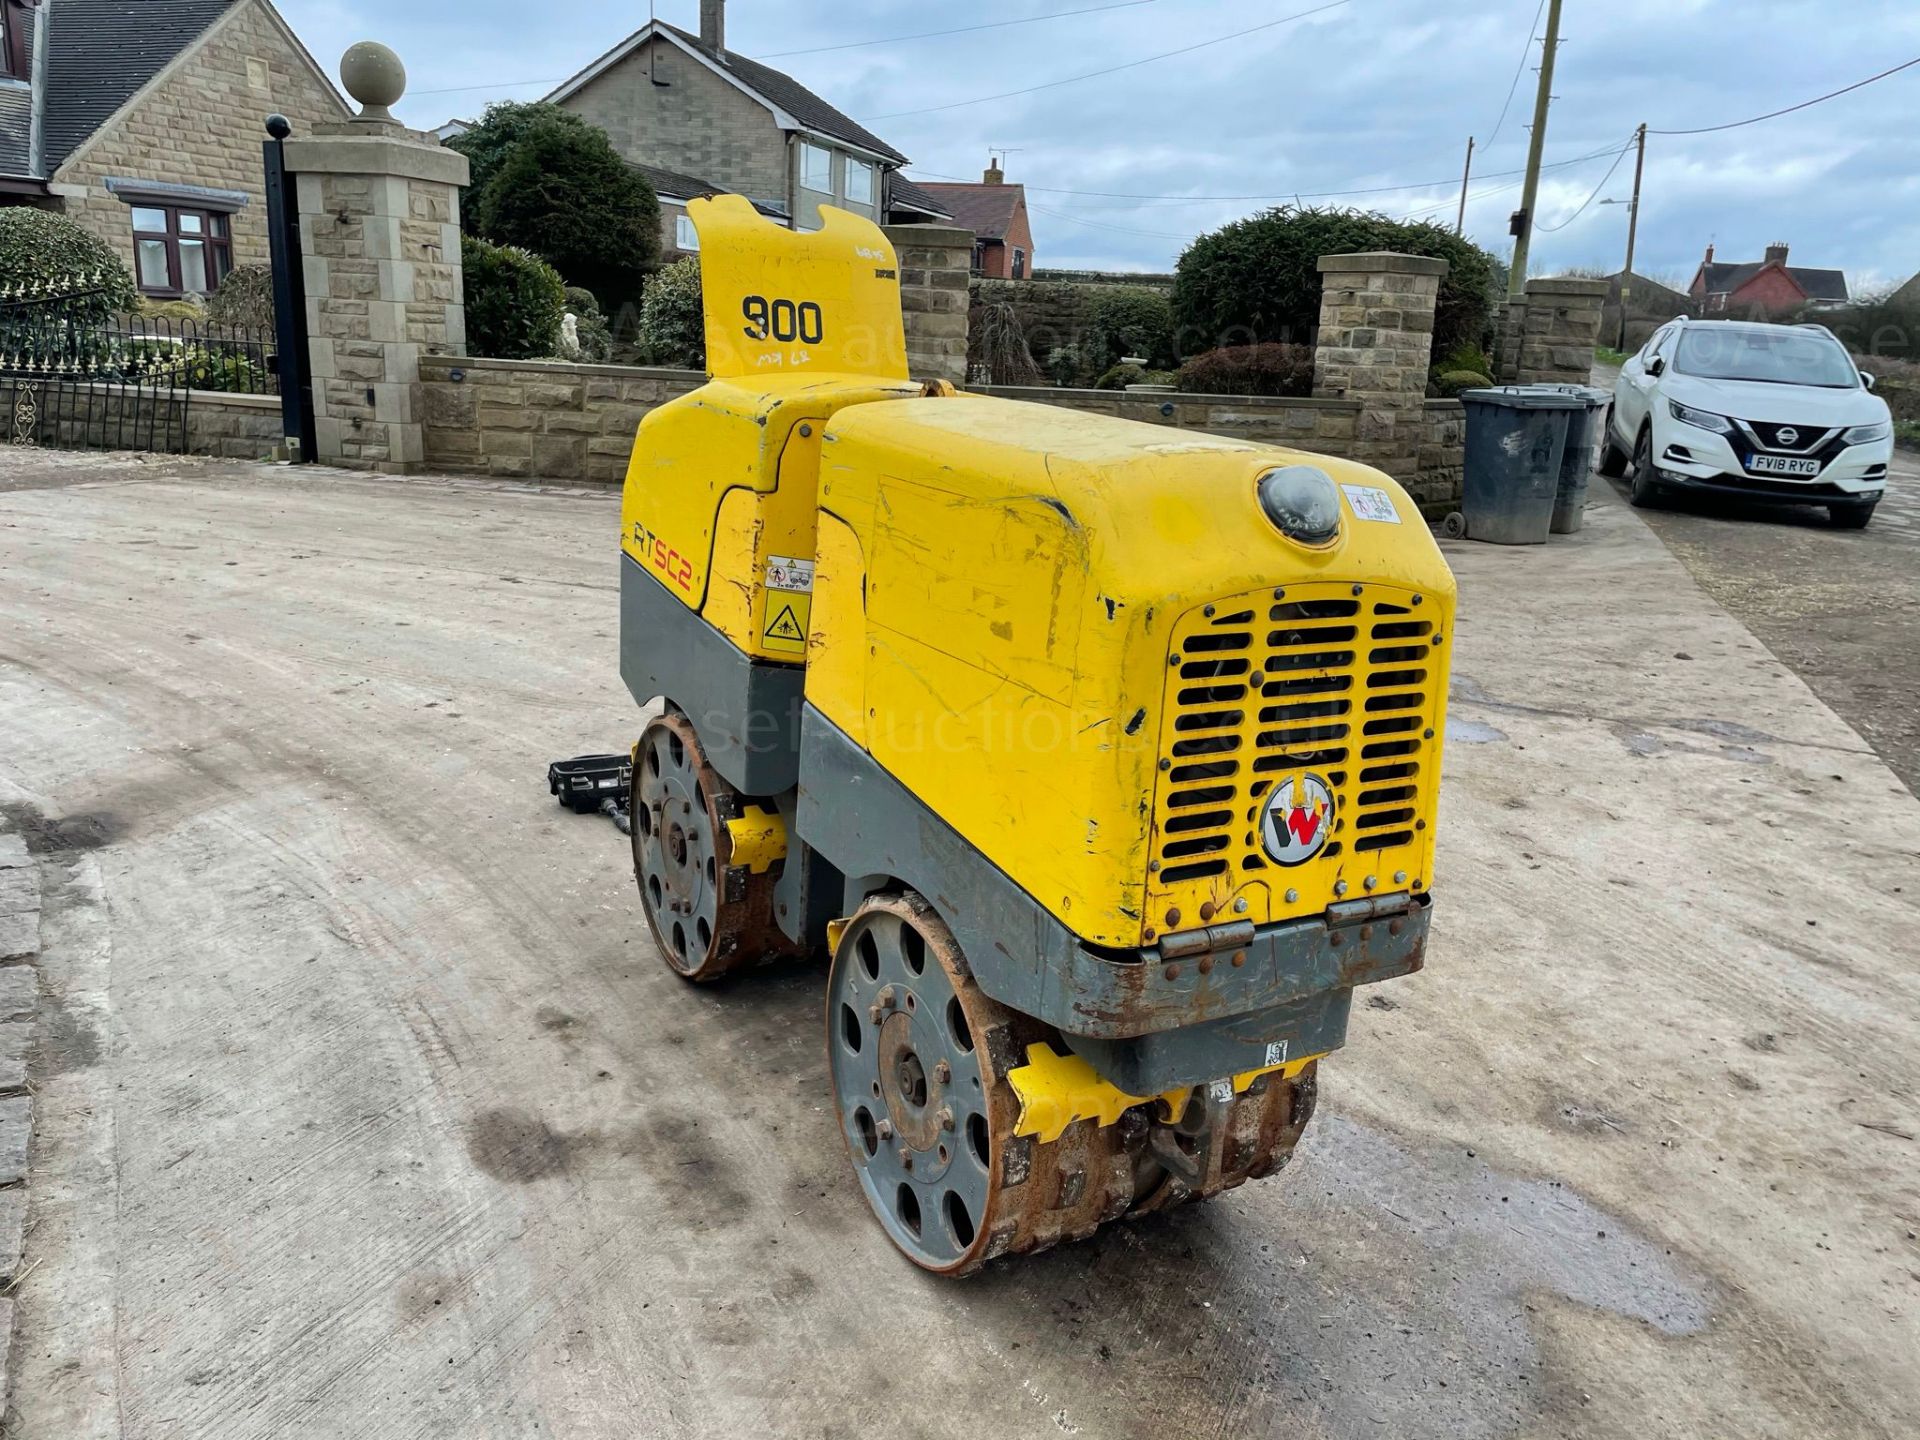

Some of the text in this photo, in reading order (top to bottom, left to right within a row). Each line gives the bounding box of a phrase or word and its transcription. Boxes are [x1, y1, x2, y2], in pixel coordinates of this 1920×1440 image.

[742, 295, 823, 345] 900
[1756, 457, 1816, 473] FV18 RYG
